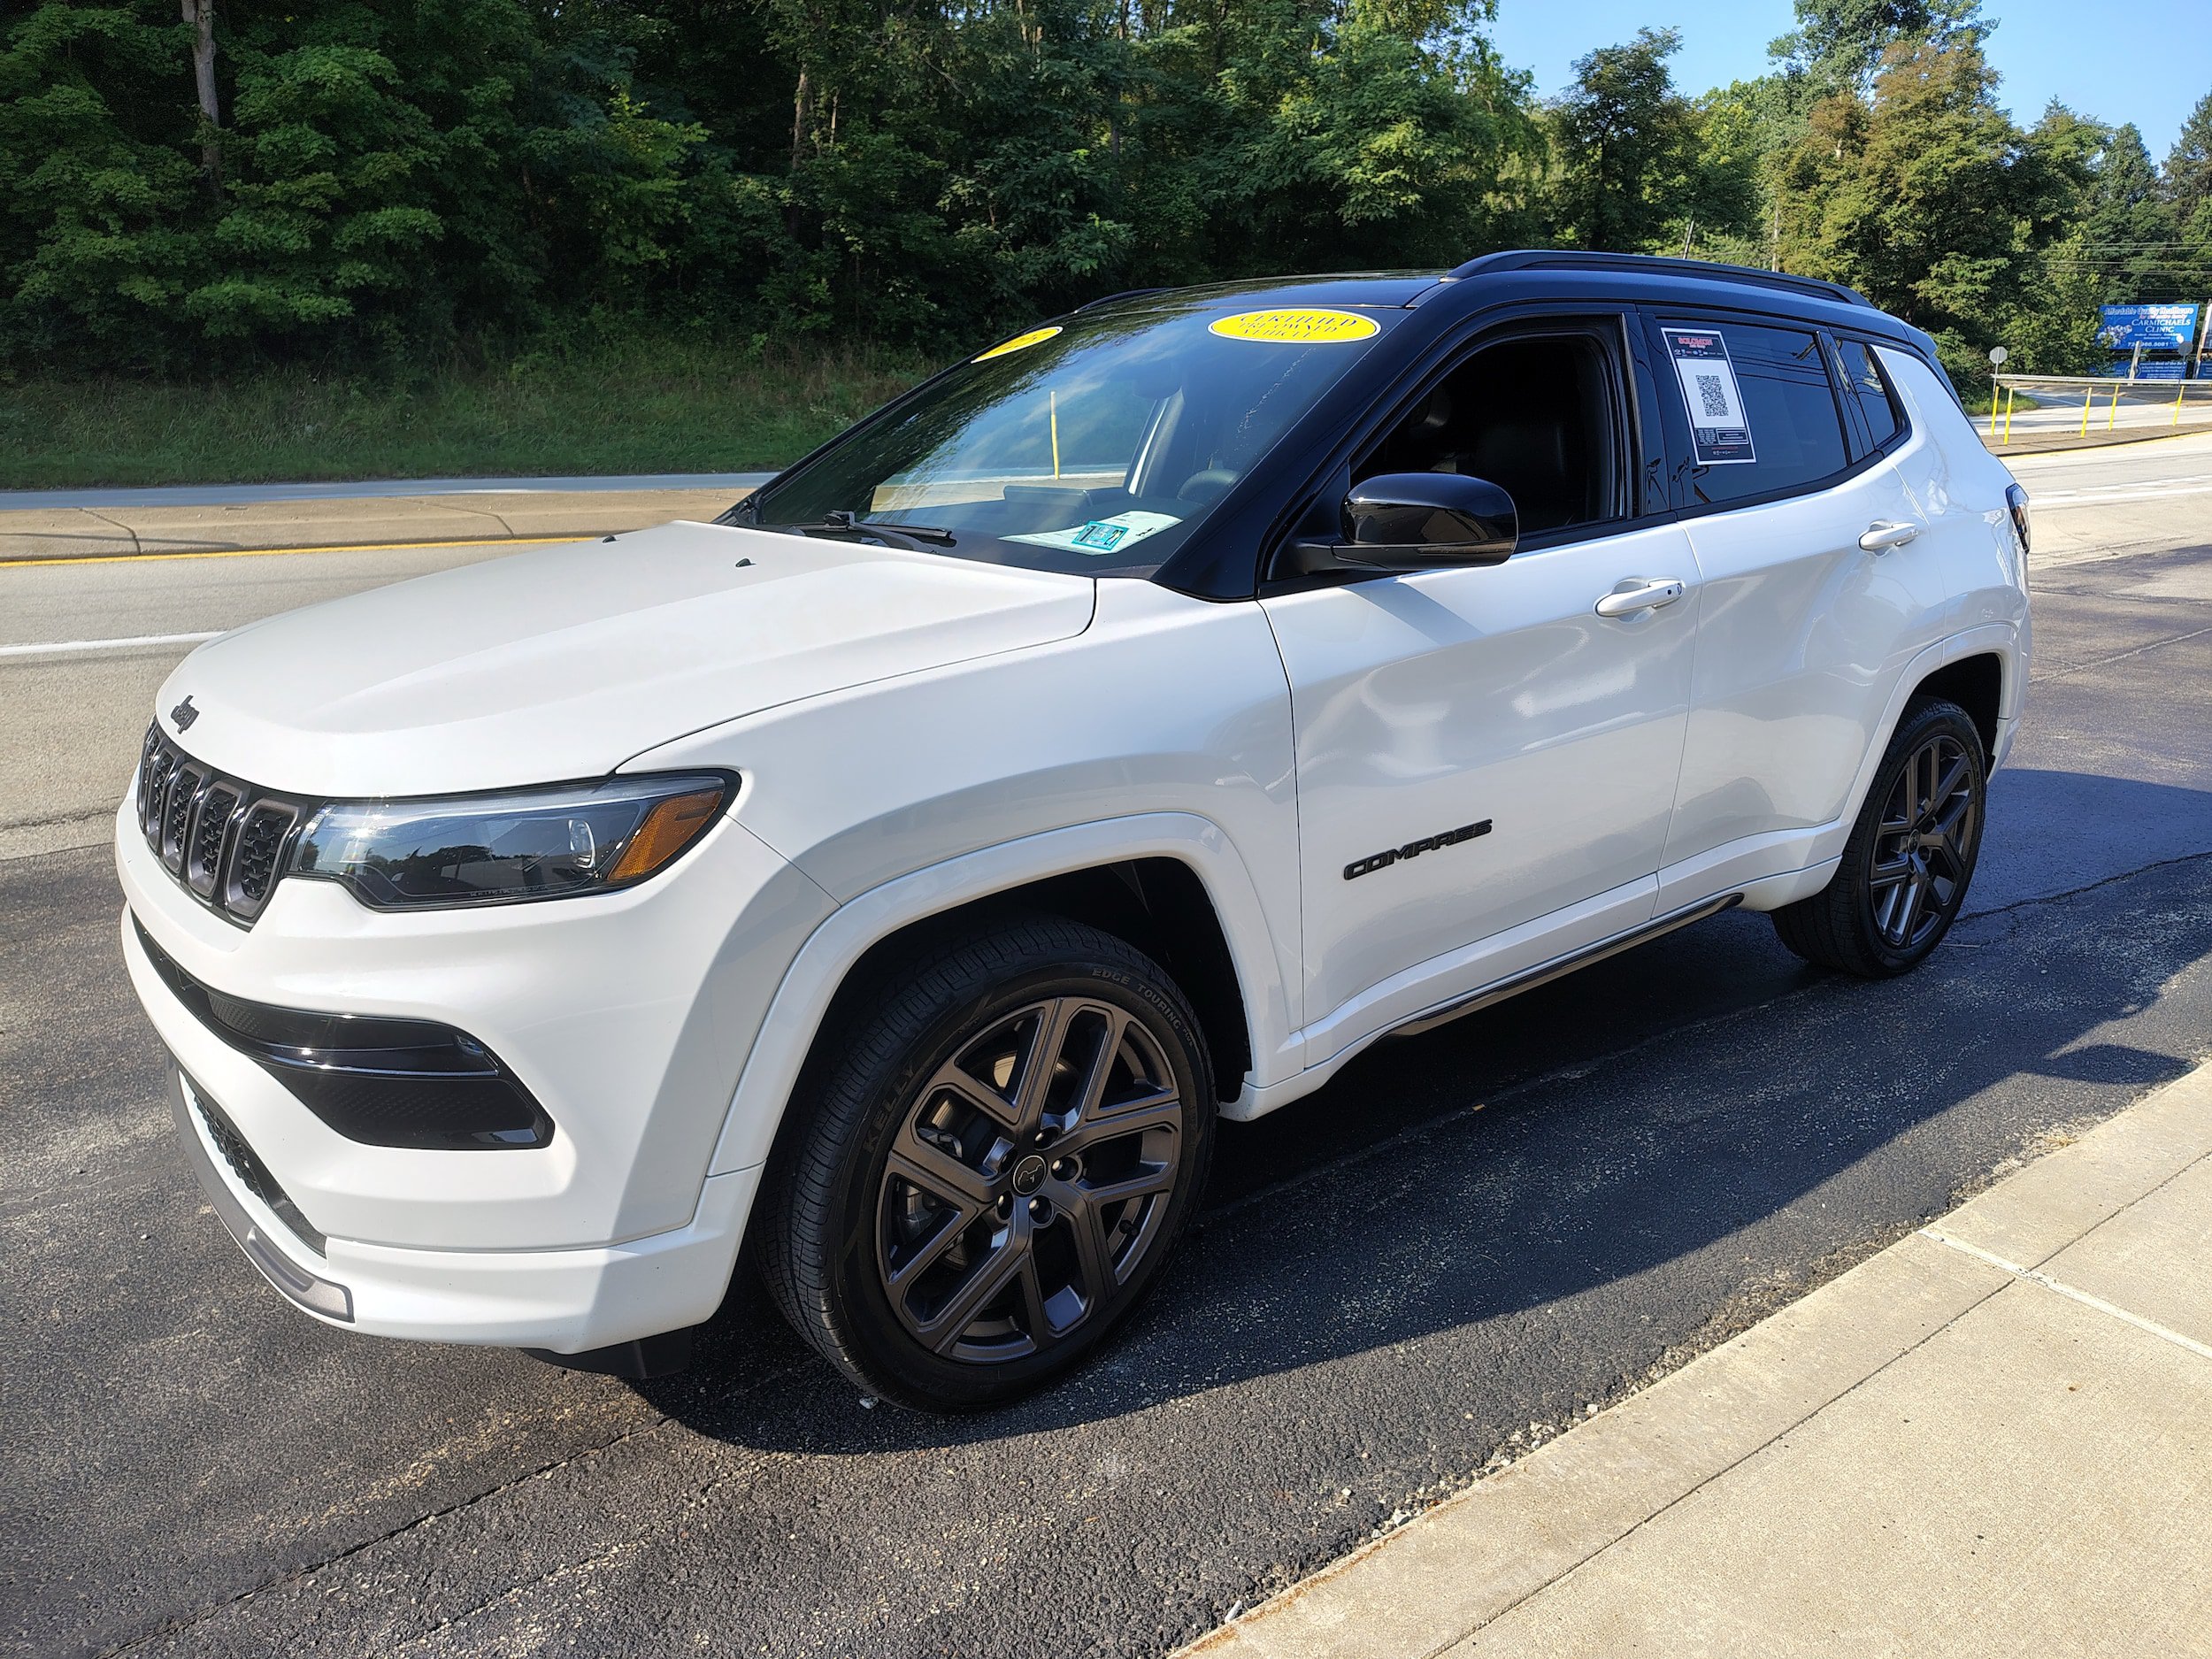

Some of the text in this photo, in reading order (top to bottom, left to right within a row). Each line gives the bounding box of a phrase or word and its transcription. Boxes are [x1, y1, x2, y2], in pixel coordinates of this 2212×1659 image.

[1343, 818, 1493, 880] COMPASS
[1092, 968, 1131, 985] EDGE
[1136, 983, 1181, 1029] TOURING
